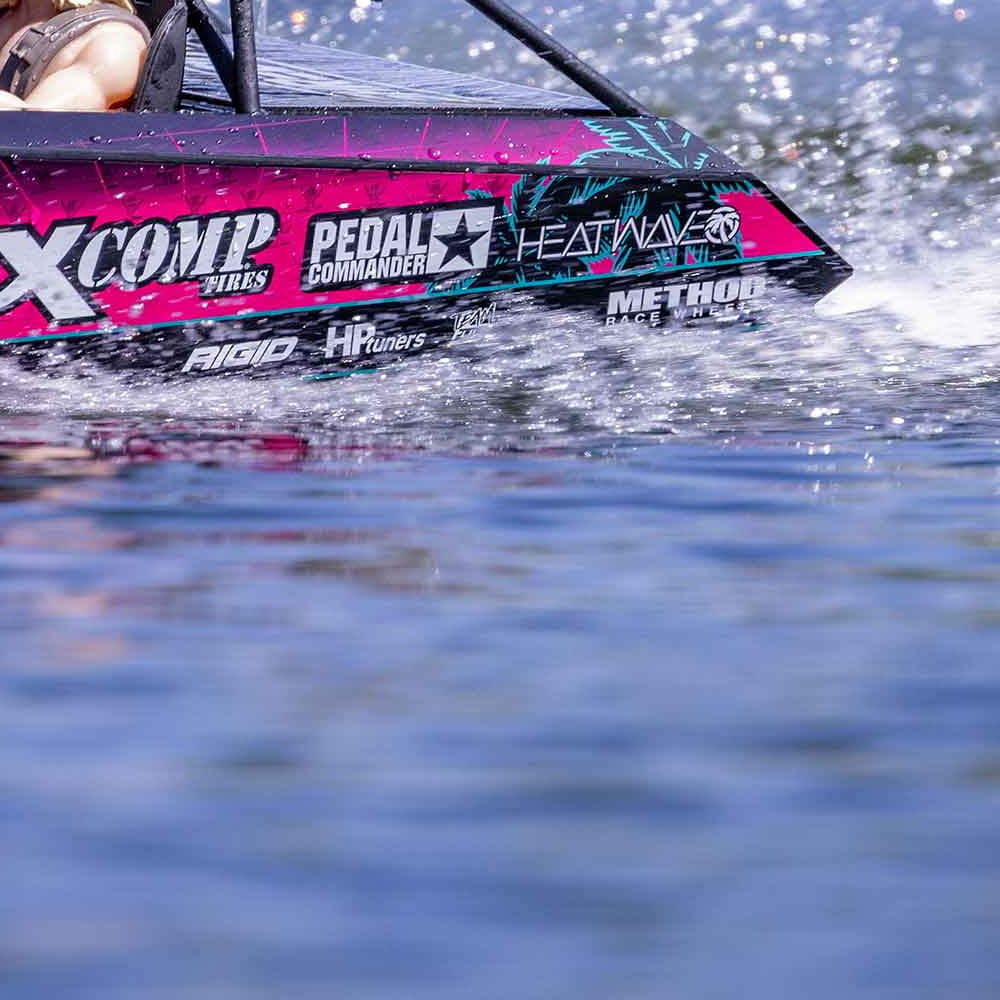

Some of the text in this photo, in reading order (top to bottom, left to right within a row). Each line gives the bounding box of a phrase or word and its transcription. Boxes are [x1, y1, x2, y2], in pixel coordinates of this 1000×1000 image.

[310, 213, 428, 264] PEDAL
[204, 270, 268, 294] TIRES
[308, 254, 428, 284] COMMANDER
[607, 276, 765, 315] METHOD
[606, 311, 660, 327] RACE
[181, 337, 298, 372] RIGID
